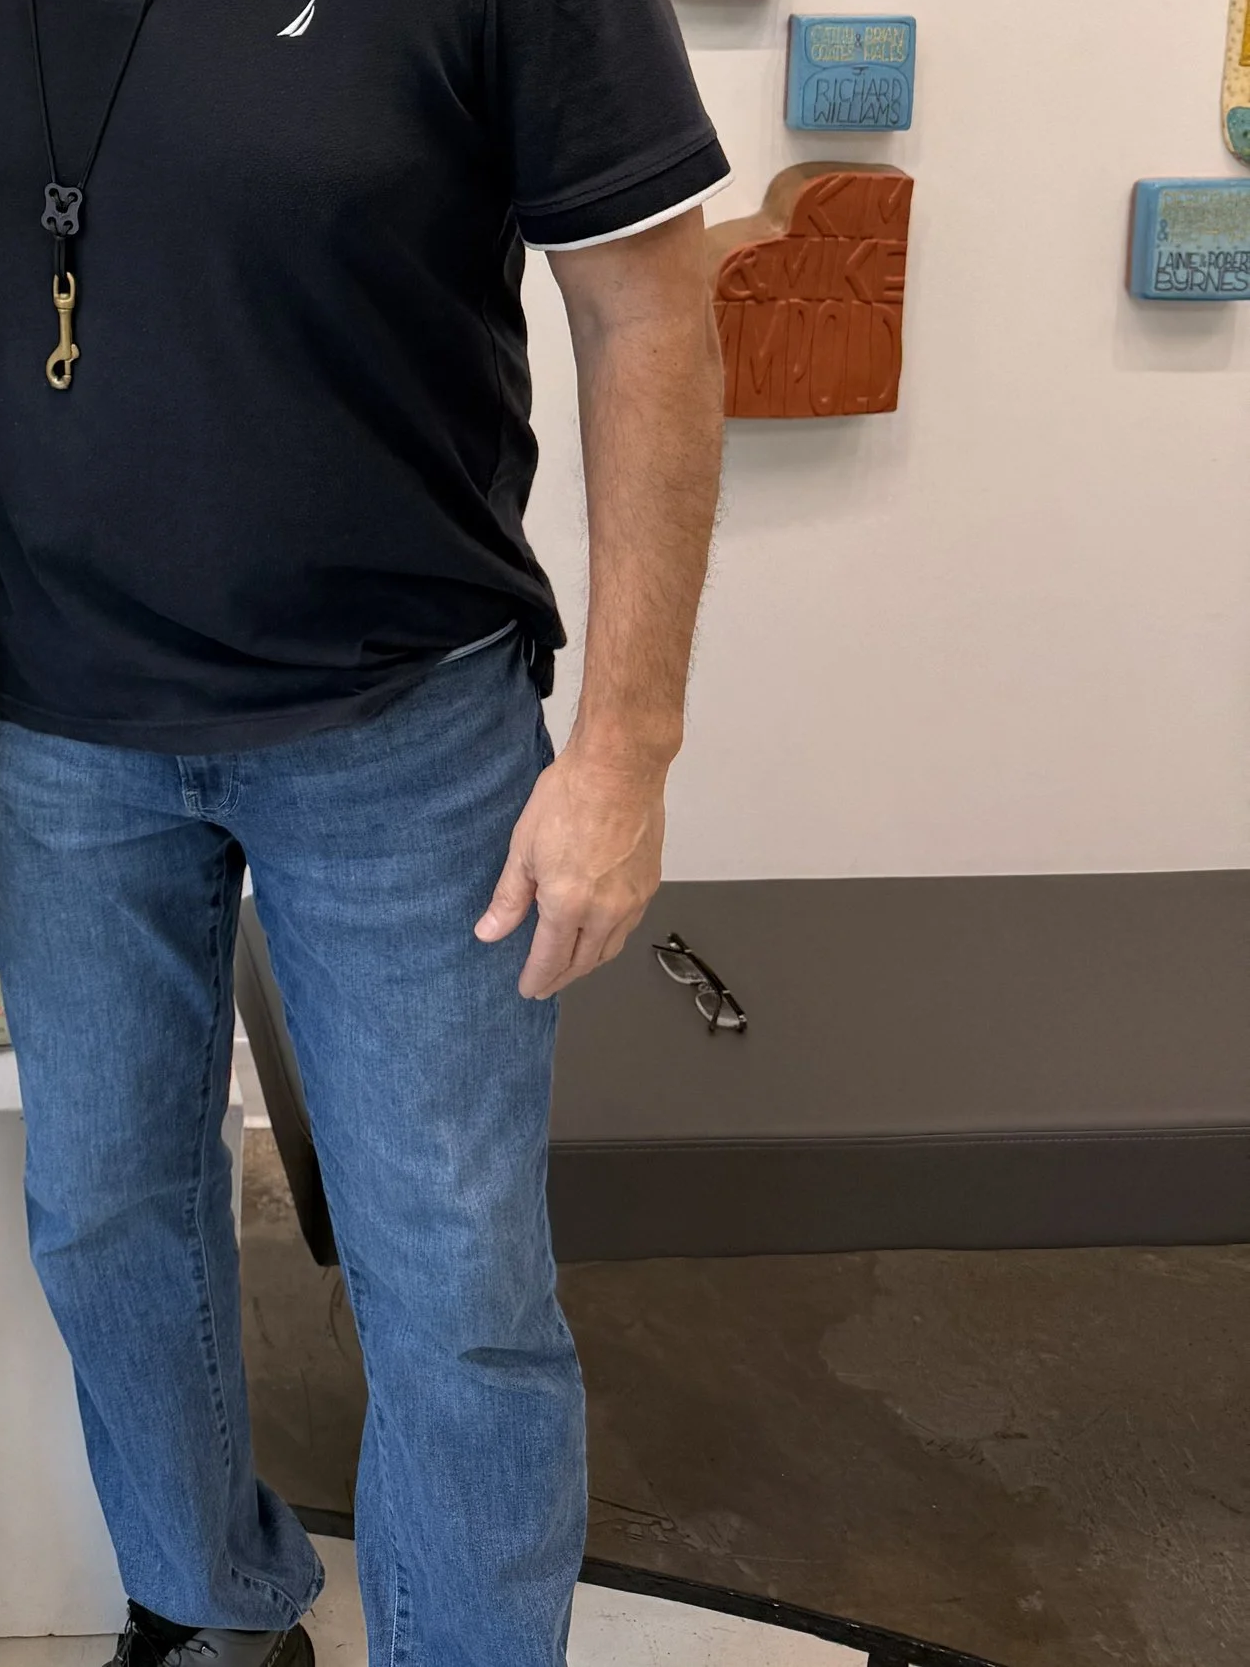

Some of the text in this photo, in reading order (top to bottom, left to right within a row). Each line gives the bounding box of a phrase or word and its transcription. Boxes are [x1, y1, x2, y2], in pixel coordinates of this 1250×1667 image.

[816, 79, 902, 102] RICHARD
[814, 102, 900, 125] WILLIAMS
[1157, 219, 1169, 242] &
[718, 239, 907, 305] & MIKE
[1154, 267, 1249, 292] BYRNES
